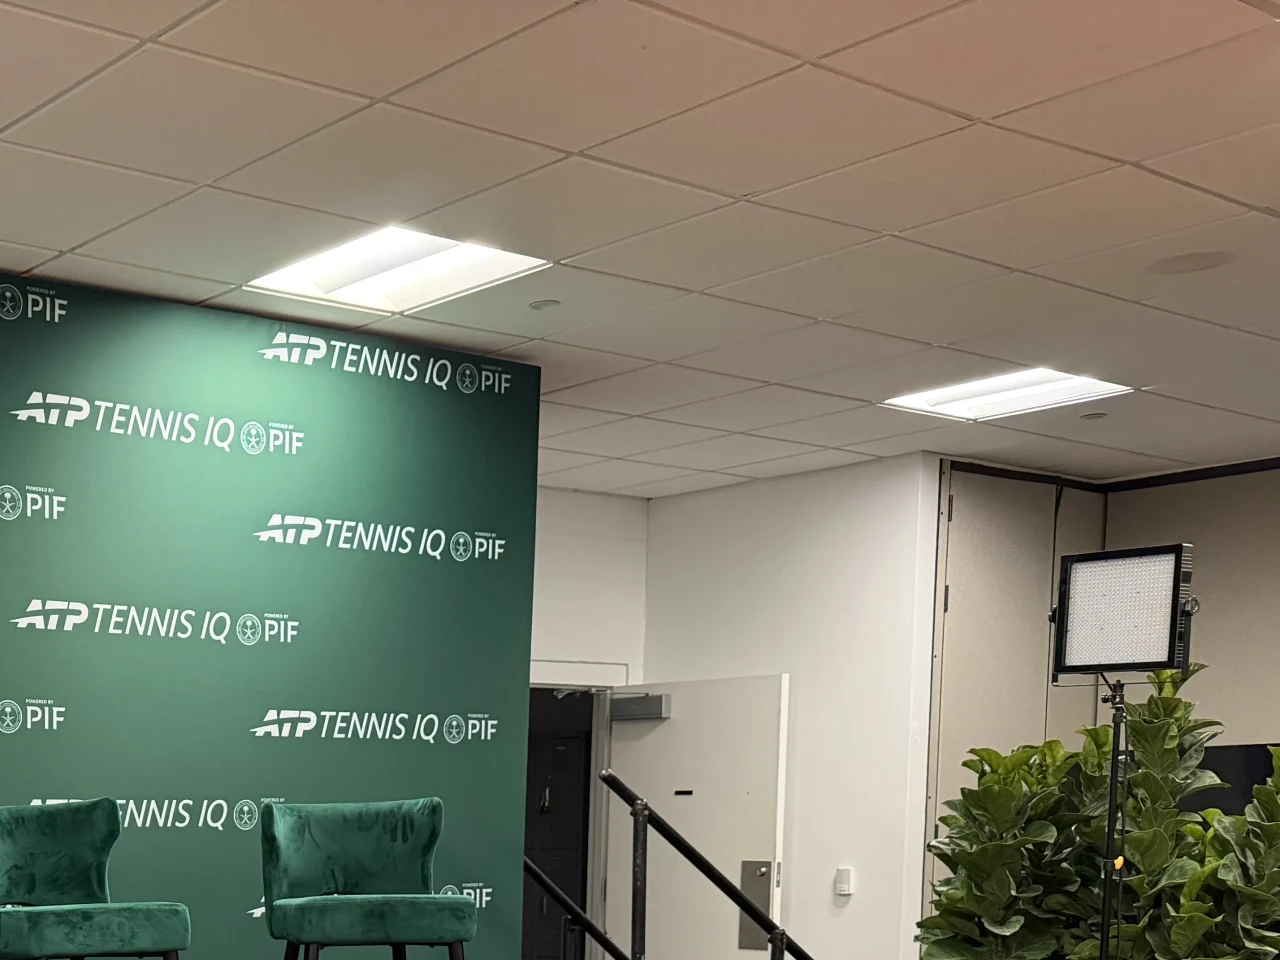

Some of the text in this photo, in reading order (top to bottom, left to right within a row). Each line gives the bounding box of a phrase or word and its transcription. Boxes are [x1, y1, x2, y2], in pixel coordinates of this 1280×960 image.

[28, 294, 67, 322] PIF
[258, 332, 326, 365] ATP
[331, 341, 420, 381] TENNIS
[425, 358, 451, 390] IQ
[481, 371, 511, 394] PIF
[10, 392, 90, 427] ATP
[95, 401, 199, 443] TENNIS
[204, 417, 234, 451] IQ
[270, 429, 304, 454] PIF
[27, 493, 66, 519] PIF
[253, 514, 322, 544] ATP
[325, 519, 415, 553] TENNIS
[419, 529, 445, 560] IQ
[475, 538, 505, 559] PIF
[10, 599, 88, 631] ATP
[93, 604, 195, 638] TENNIS
[201, 612, 230, 644] IQ
[265, 620, 299, 642] PIF
[27, 706, 65, 729] PIF
[249, 710, 317, 737] ATP
[320, 711, 408, 739] TENNIS
[412, 714, 438, 743] IQ
[468, 720, 498, 740] PIF
[116, 799, 193, 827] NNIS
[198, 800, 228, 831] IQ
